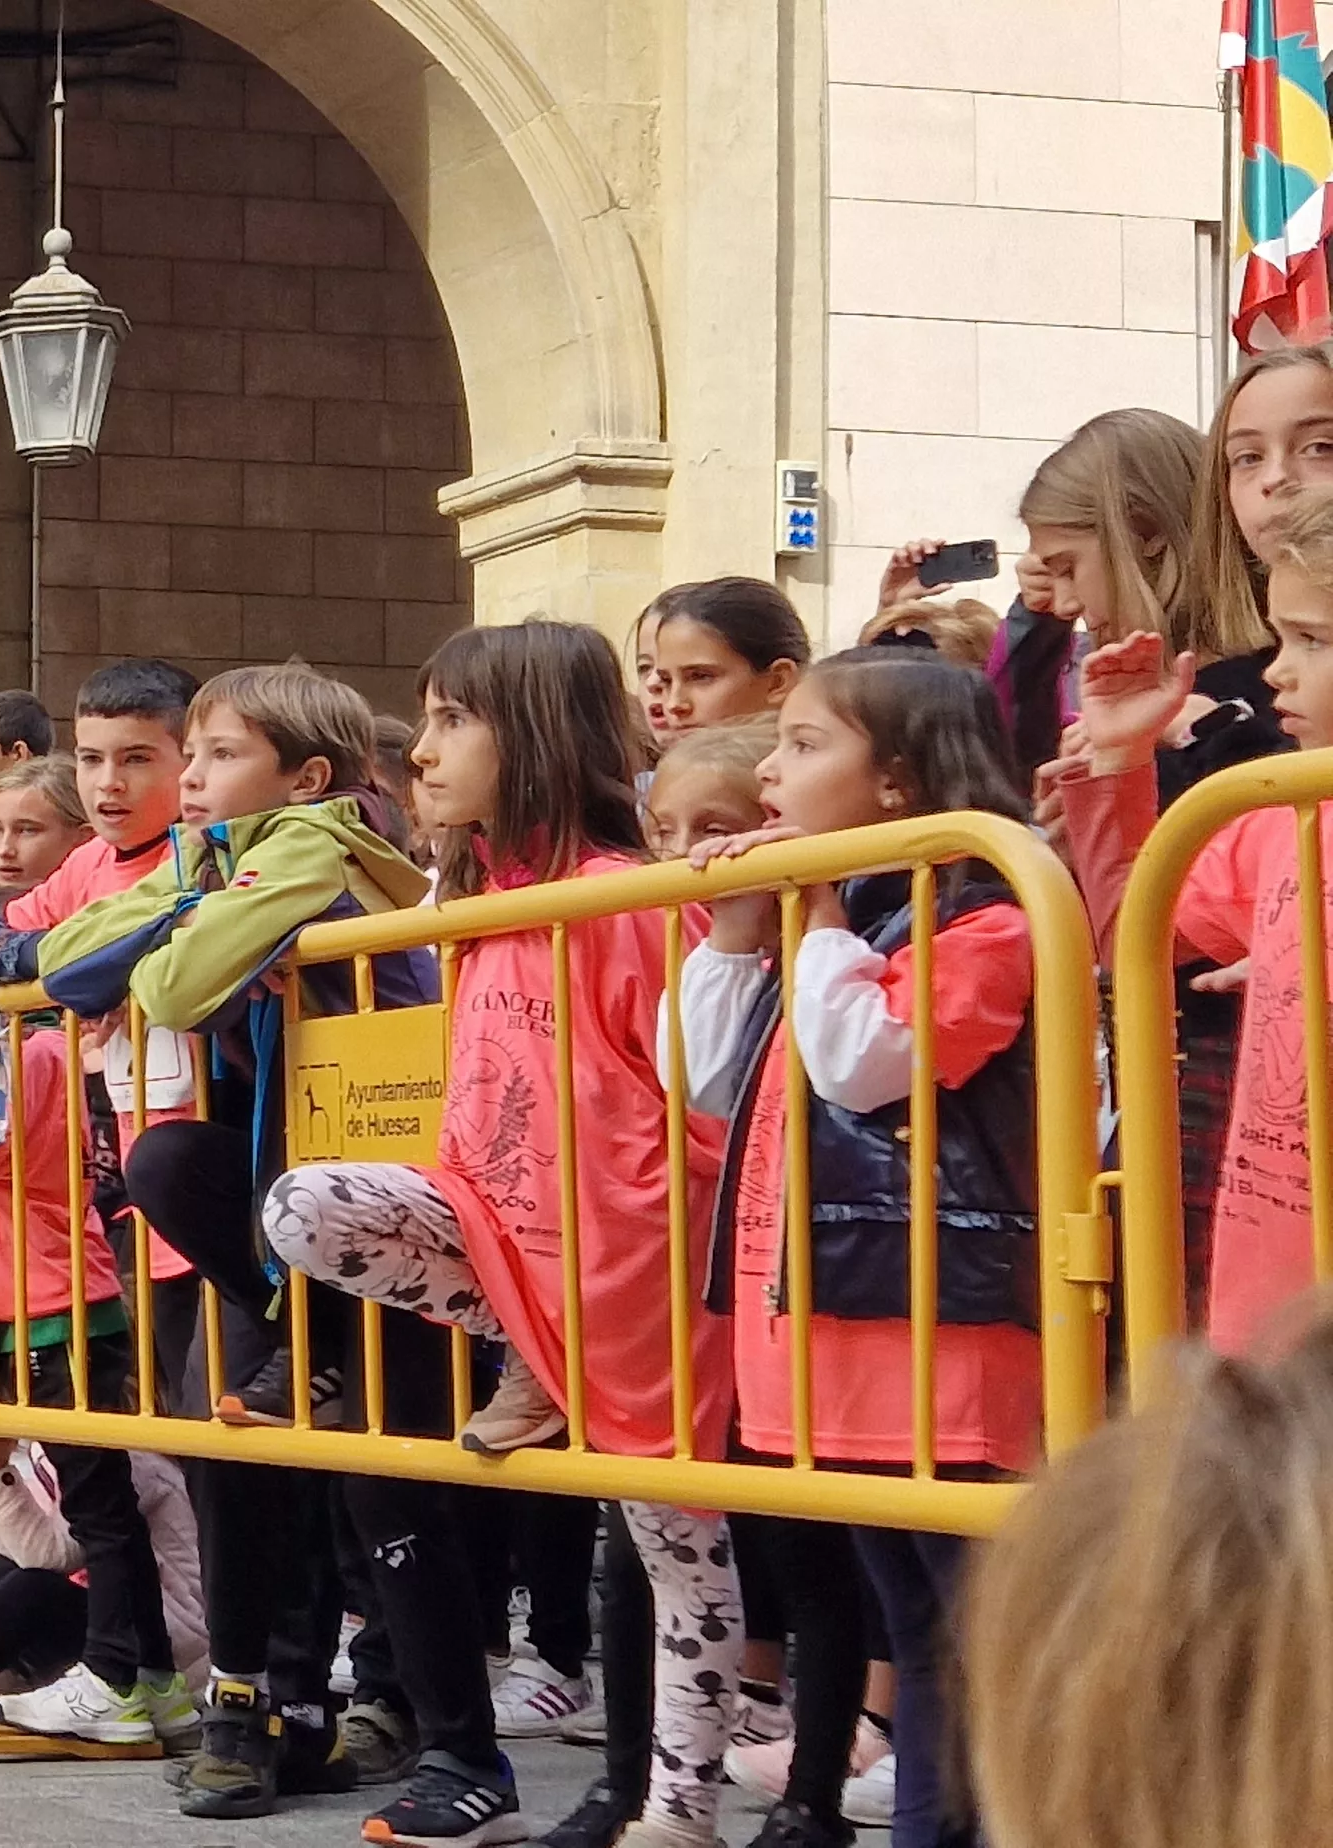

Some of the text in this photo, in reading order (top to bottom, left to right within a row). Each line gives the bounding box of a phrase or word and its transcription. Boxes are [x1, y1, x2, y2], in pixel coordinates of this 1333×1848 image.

[345, 1074, 443, 1109] Ayuntamiento
[346, 1112, 420, 1138] de Huesca
